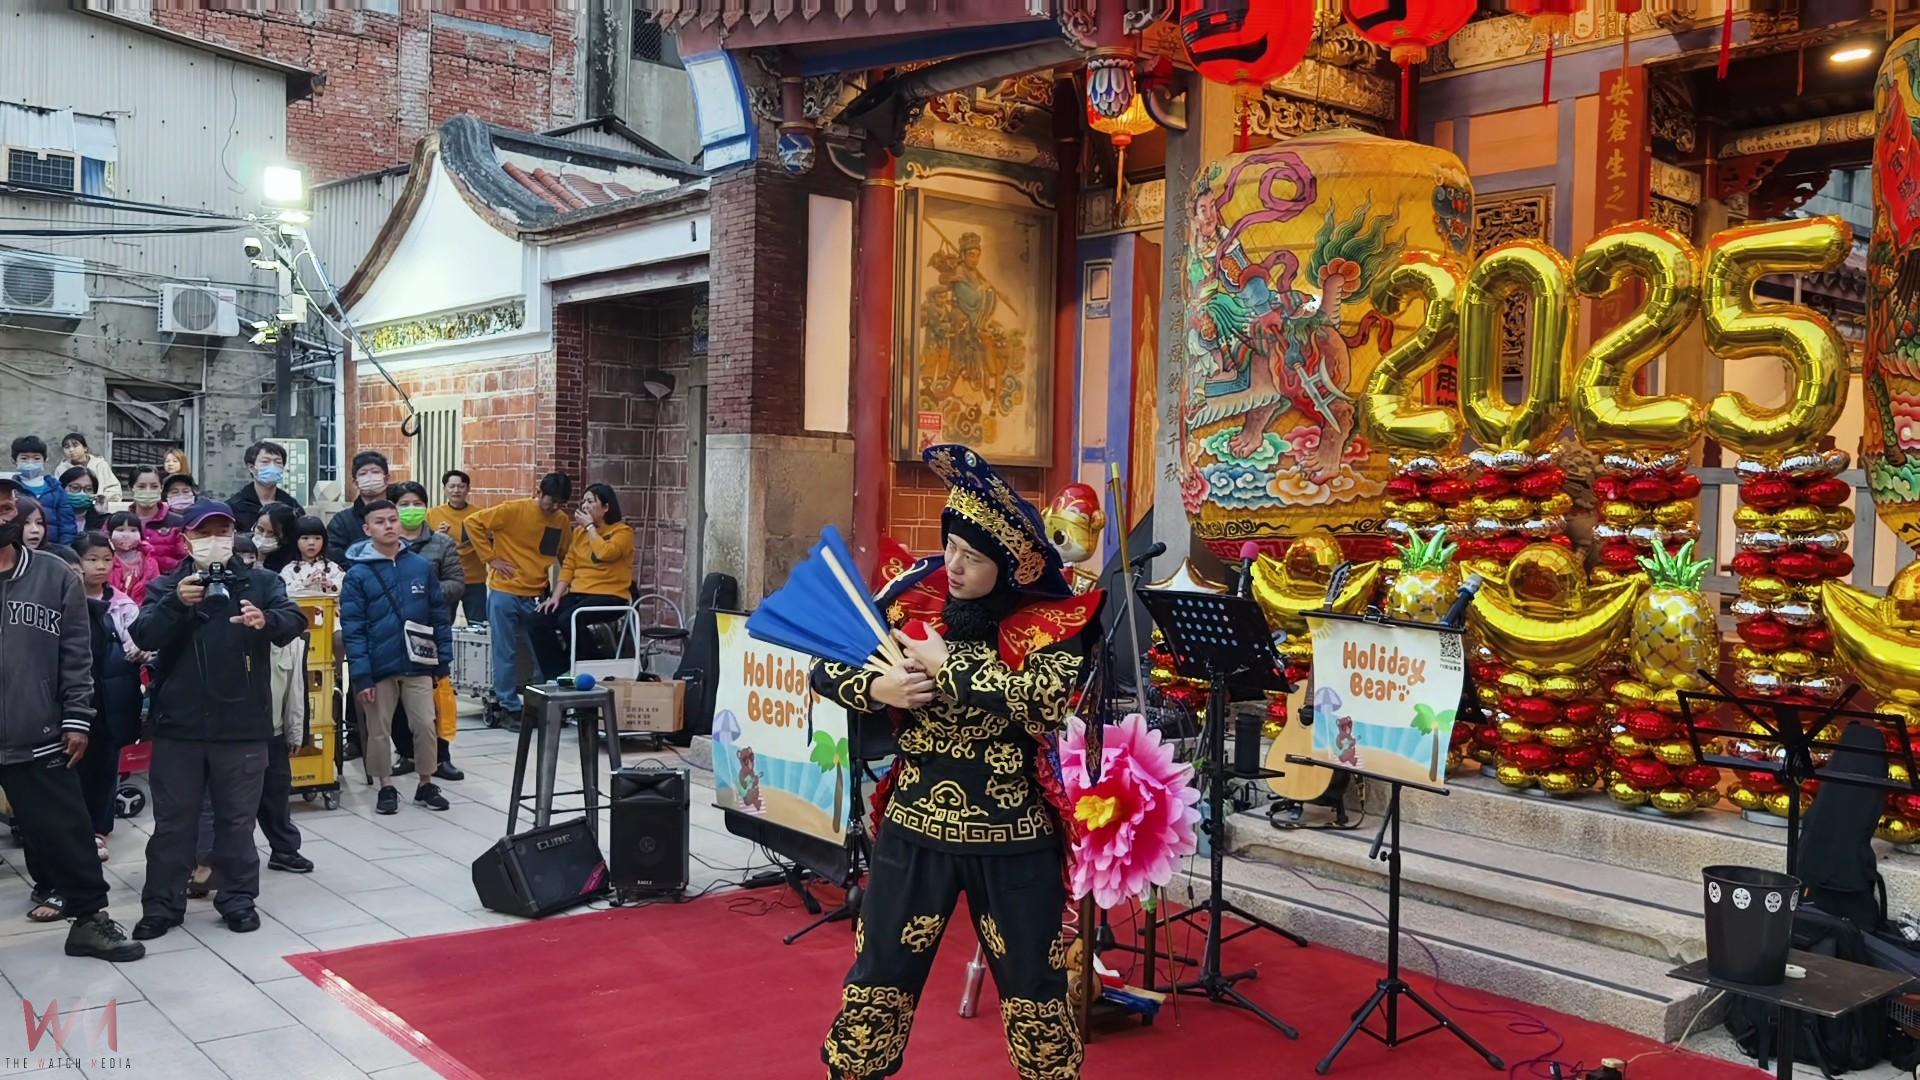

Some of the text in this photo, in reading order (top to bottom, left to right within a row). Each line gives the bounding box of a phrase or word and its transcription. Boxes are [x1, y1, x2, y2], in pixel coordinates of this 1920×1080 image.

[1605, 75, 1635, 225] 安蒼生之
[1363, 215, 1853, 456] 2025
[7, 600, 61, 636] YORK
[1342, 641, 1426, 686] Holiday
[1350, 672, 1398, 701] Bear
[747, 690, 796, 728] Bear
[536, 834, 572, 851] CUBE
